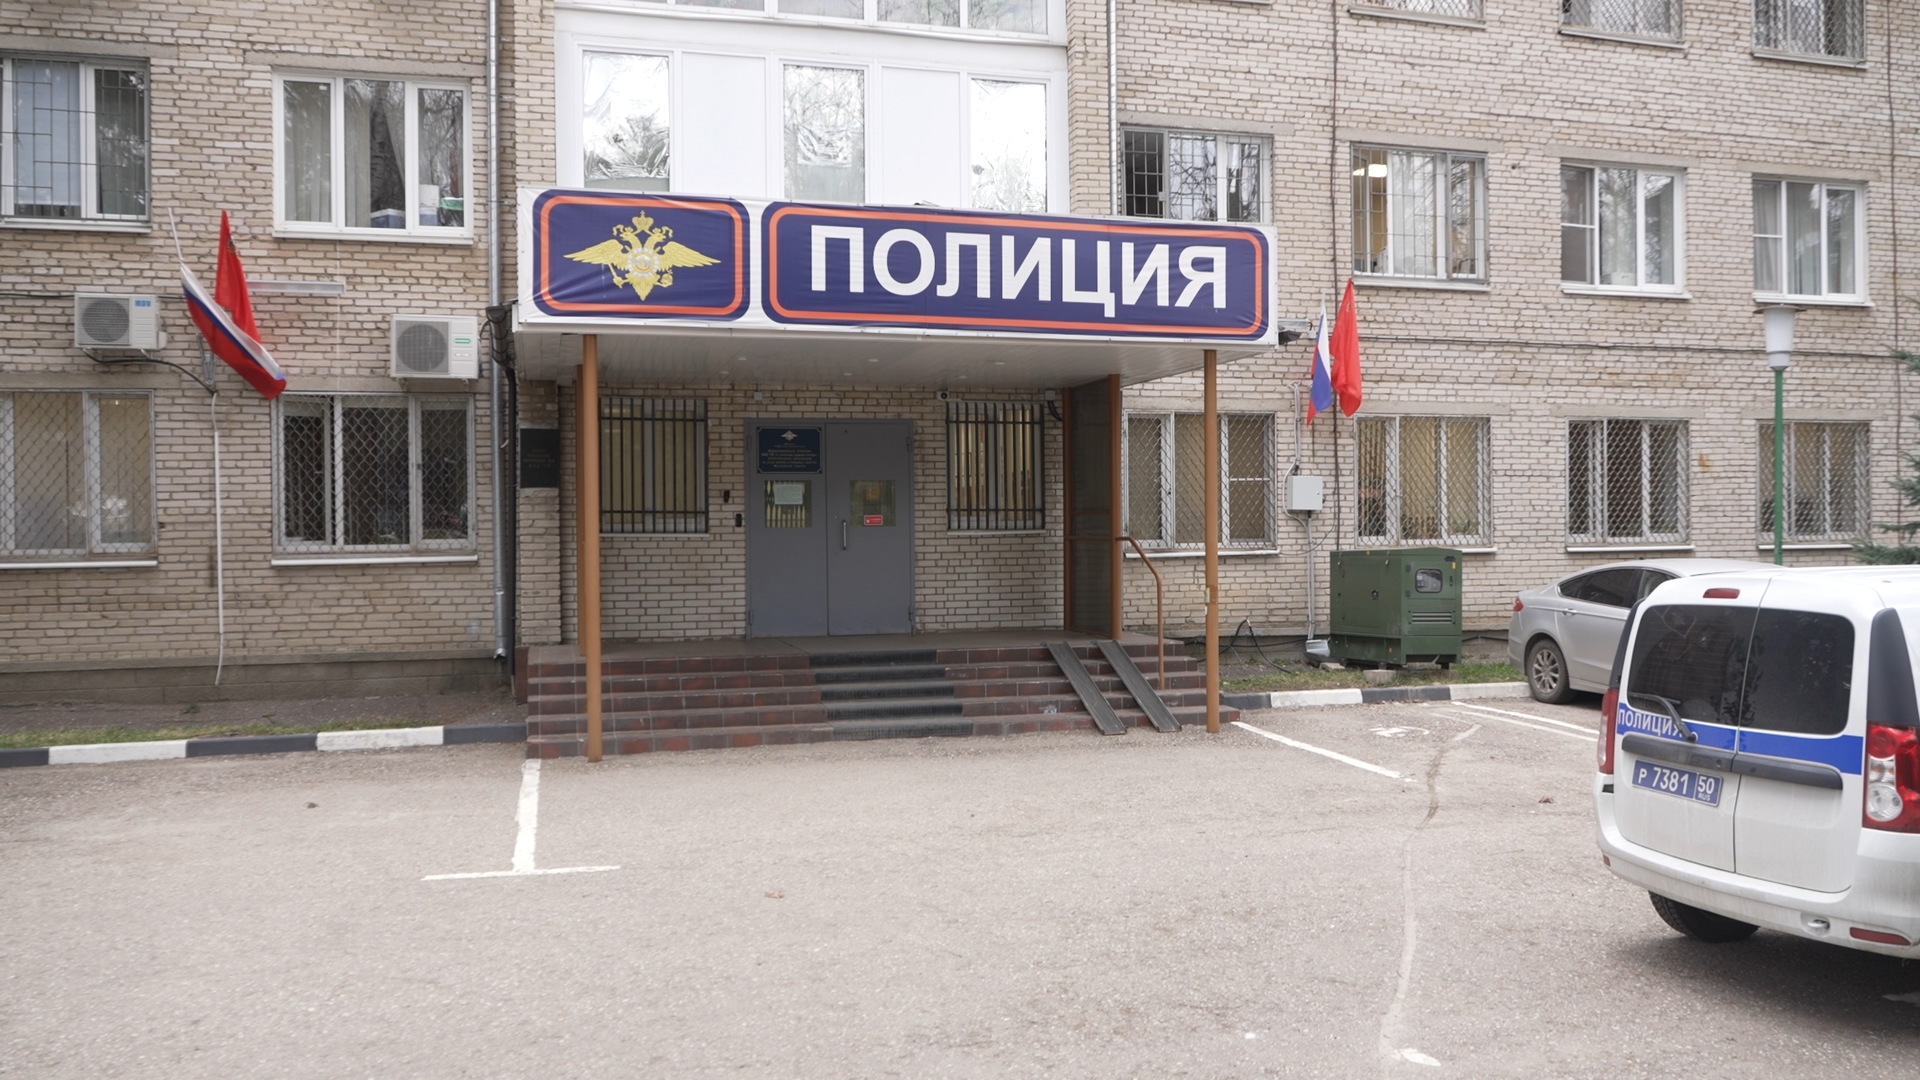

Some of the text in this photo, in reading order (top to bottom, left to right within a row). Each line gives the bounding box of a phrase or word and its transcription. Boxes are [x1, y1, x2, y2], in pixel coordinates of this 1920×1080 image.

[811, 225, 1227, 317] ПОЛИЦИЯ
[1652, 766, 1689, 795] 7381
[1697, 776, 1715, 794] 50
[1698, 793, 1711, 802] RUS
